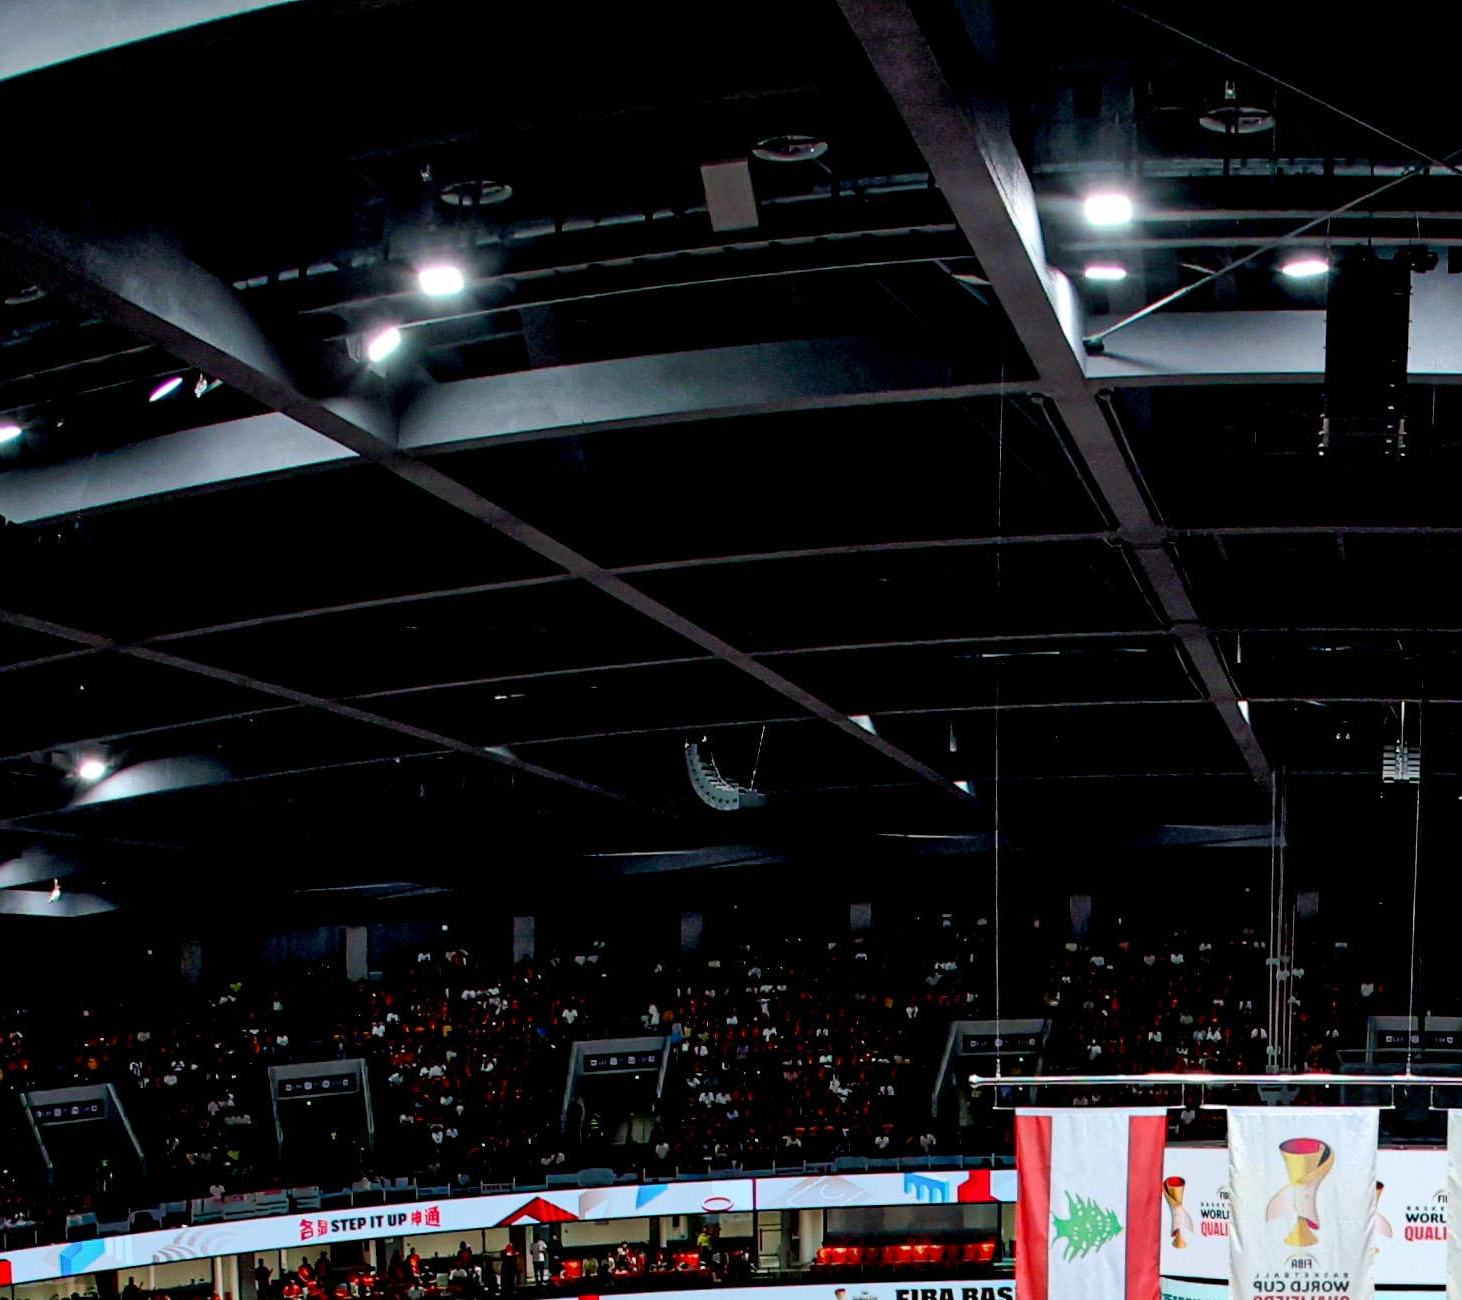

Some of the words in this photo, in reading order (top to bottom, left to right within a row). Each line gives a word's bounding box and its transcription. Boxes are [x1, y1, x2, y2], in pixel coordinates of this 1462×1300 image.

[331, 1216, 366, 1232] STEP
[370, 1214, 386, 1230] IT
[388, 1213, 407, 1228] UP
